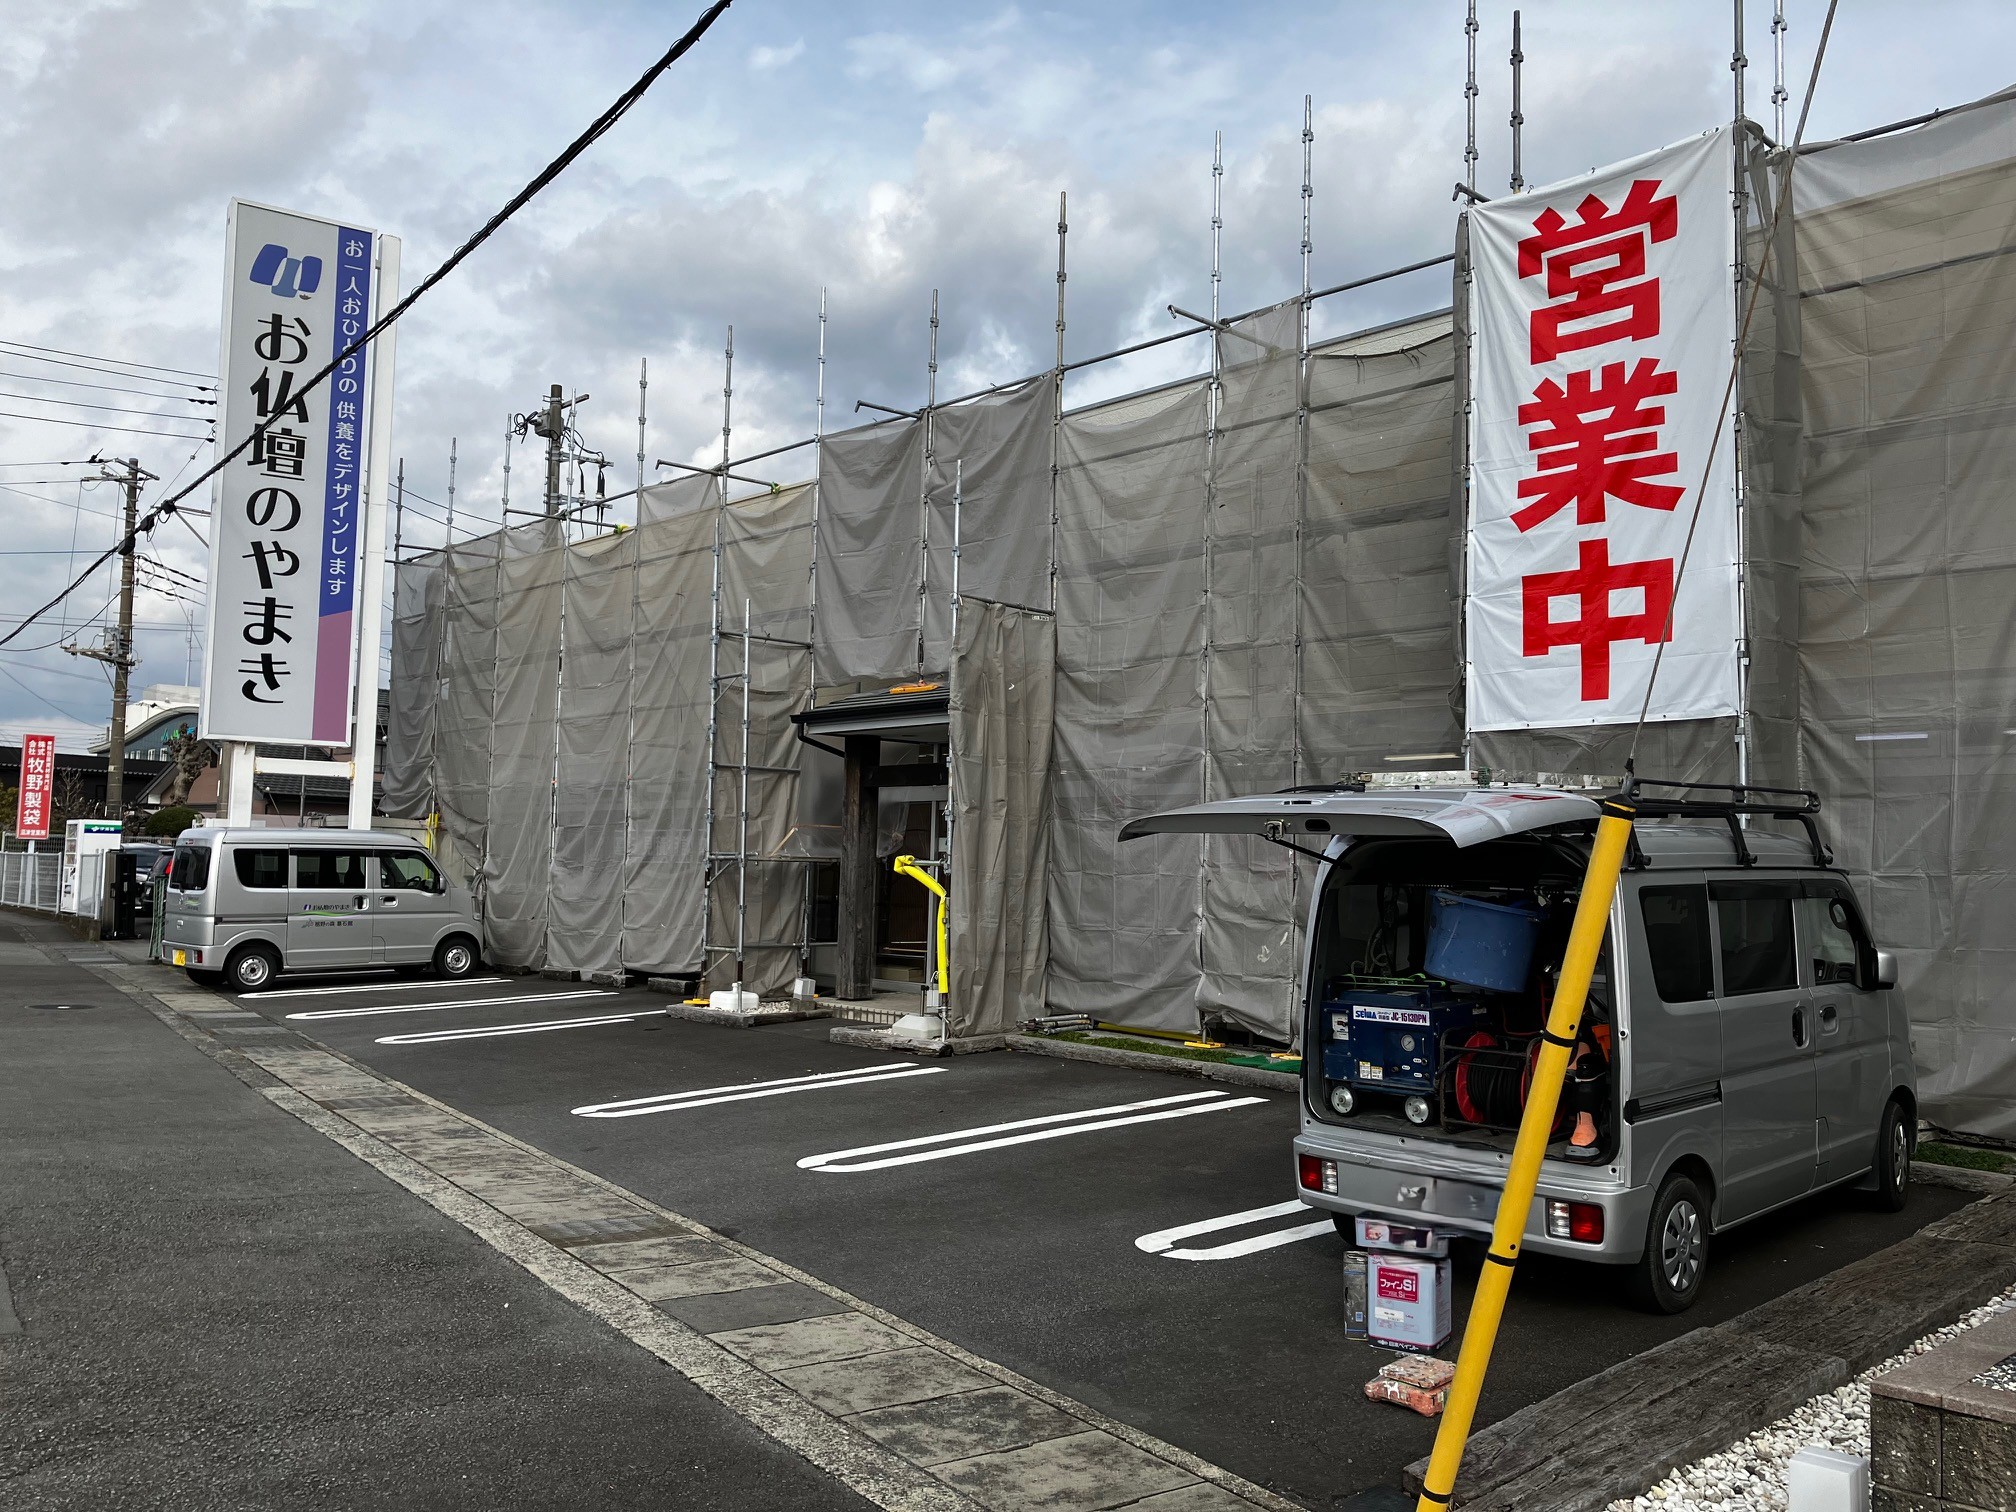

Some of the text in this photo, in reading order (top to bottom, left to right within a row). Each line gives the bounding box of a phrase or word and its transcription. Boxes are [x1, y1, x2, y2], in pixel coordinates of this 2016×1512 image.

[238, 313, 311, 703] お仏壇のやまき
[1509, 180, 1687, 701] 営業中
[23, 757, 44, 826] 牧野製袋
[1380, 1278, 1416, 1292] ファインSi
